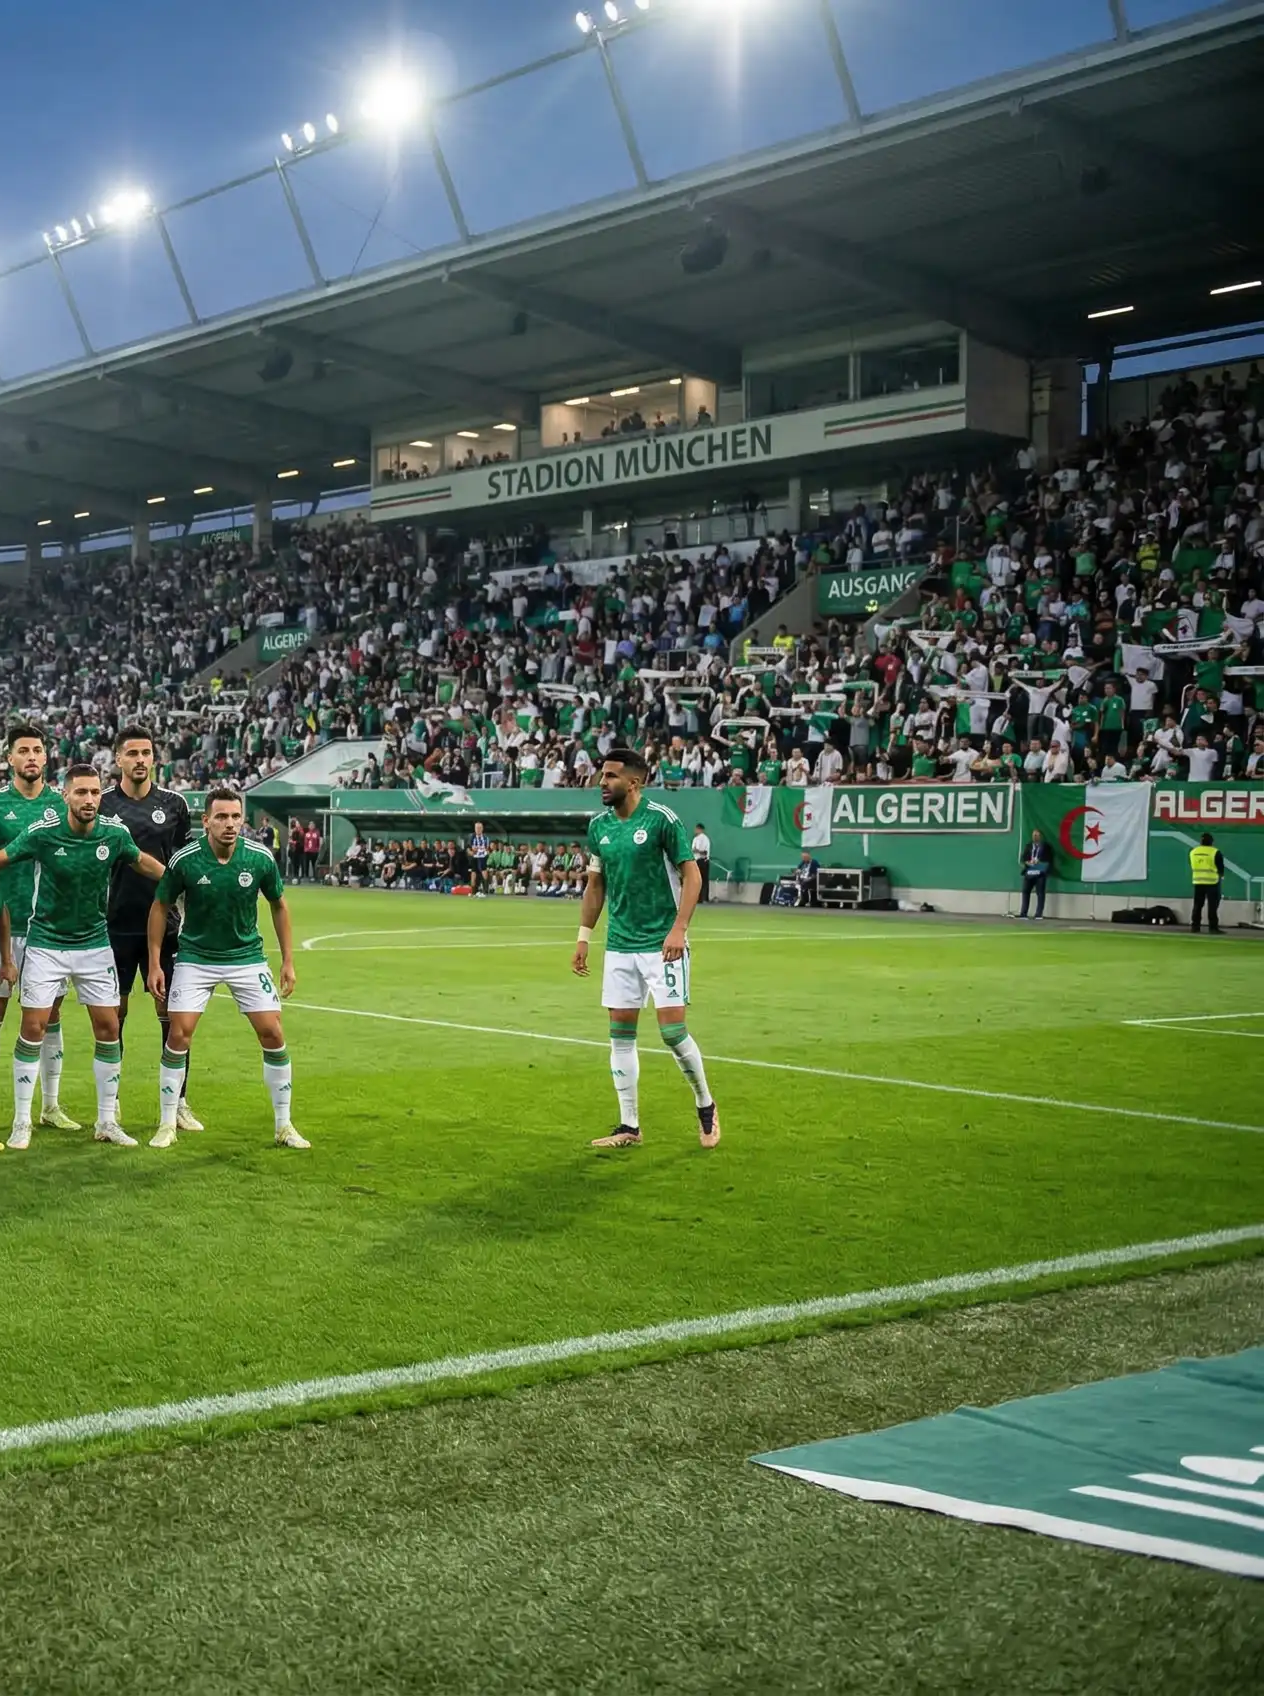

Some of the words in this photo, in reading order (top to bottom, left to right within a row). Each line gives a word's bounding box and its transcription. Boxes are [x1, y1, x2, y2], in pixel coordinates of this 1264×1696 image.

[488, 453, 604, 499] STADION
[615, 424, 772, 479] MÜNCHEN
[833, 791, 1004, 824] ALGERIEN
[258, 972, 272, 993] 8
[664, 962, 676, 988] 6
